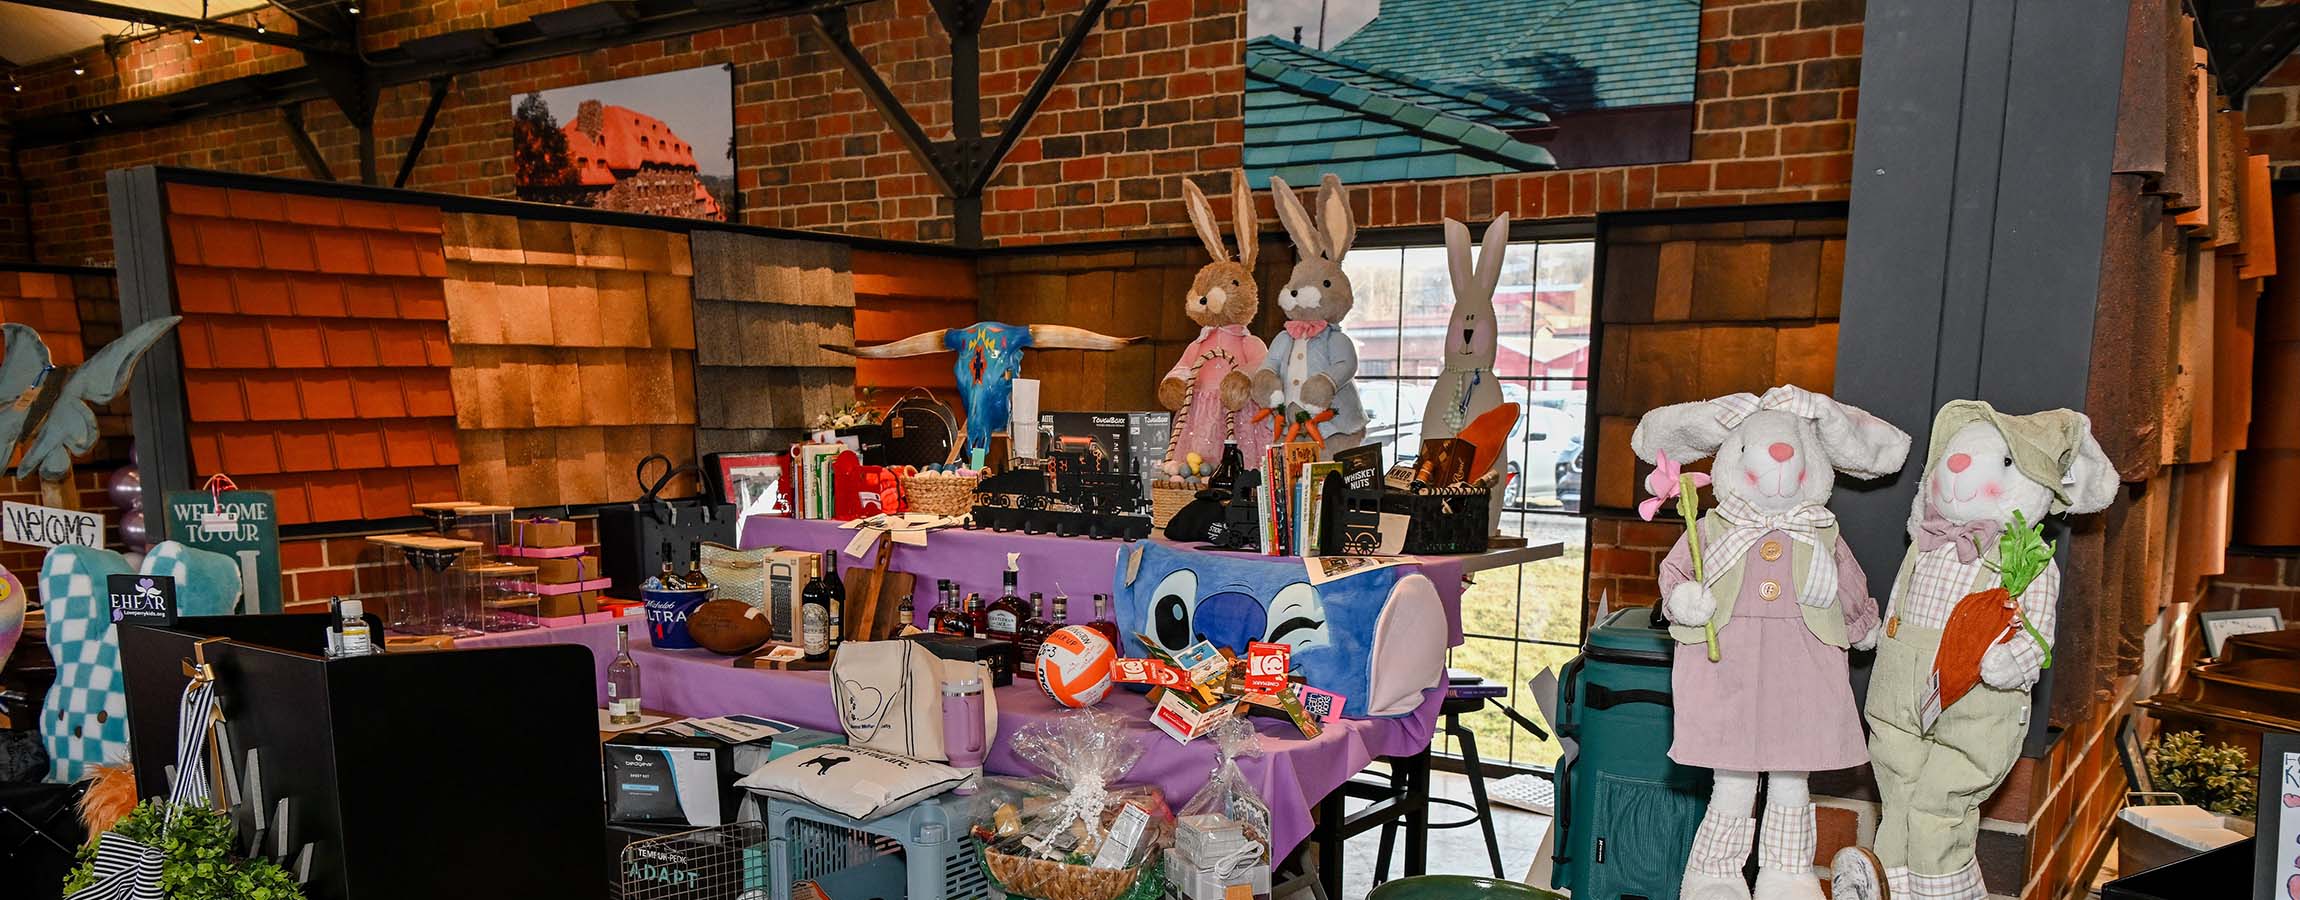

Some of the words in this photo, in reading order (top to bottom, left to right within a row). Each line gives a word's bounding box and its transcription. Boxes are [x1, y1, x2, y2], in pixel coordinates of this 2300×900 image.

[1343, 467, 1376, 485] WHISKEY
[1389, 468, 1412, 480] KNOB
[1350, 478, 1370, 491] NUTS
[645, 600, 676, 610] Michelob
[647, 609, 688, 623] LTRA
[625, 760, 654, 768] bedgear
[628, 861, 698, 889] ADAPT
